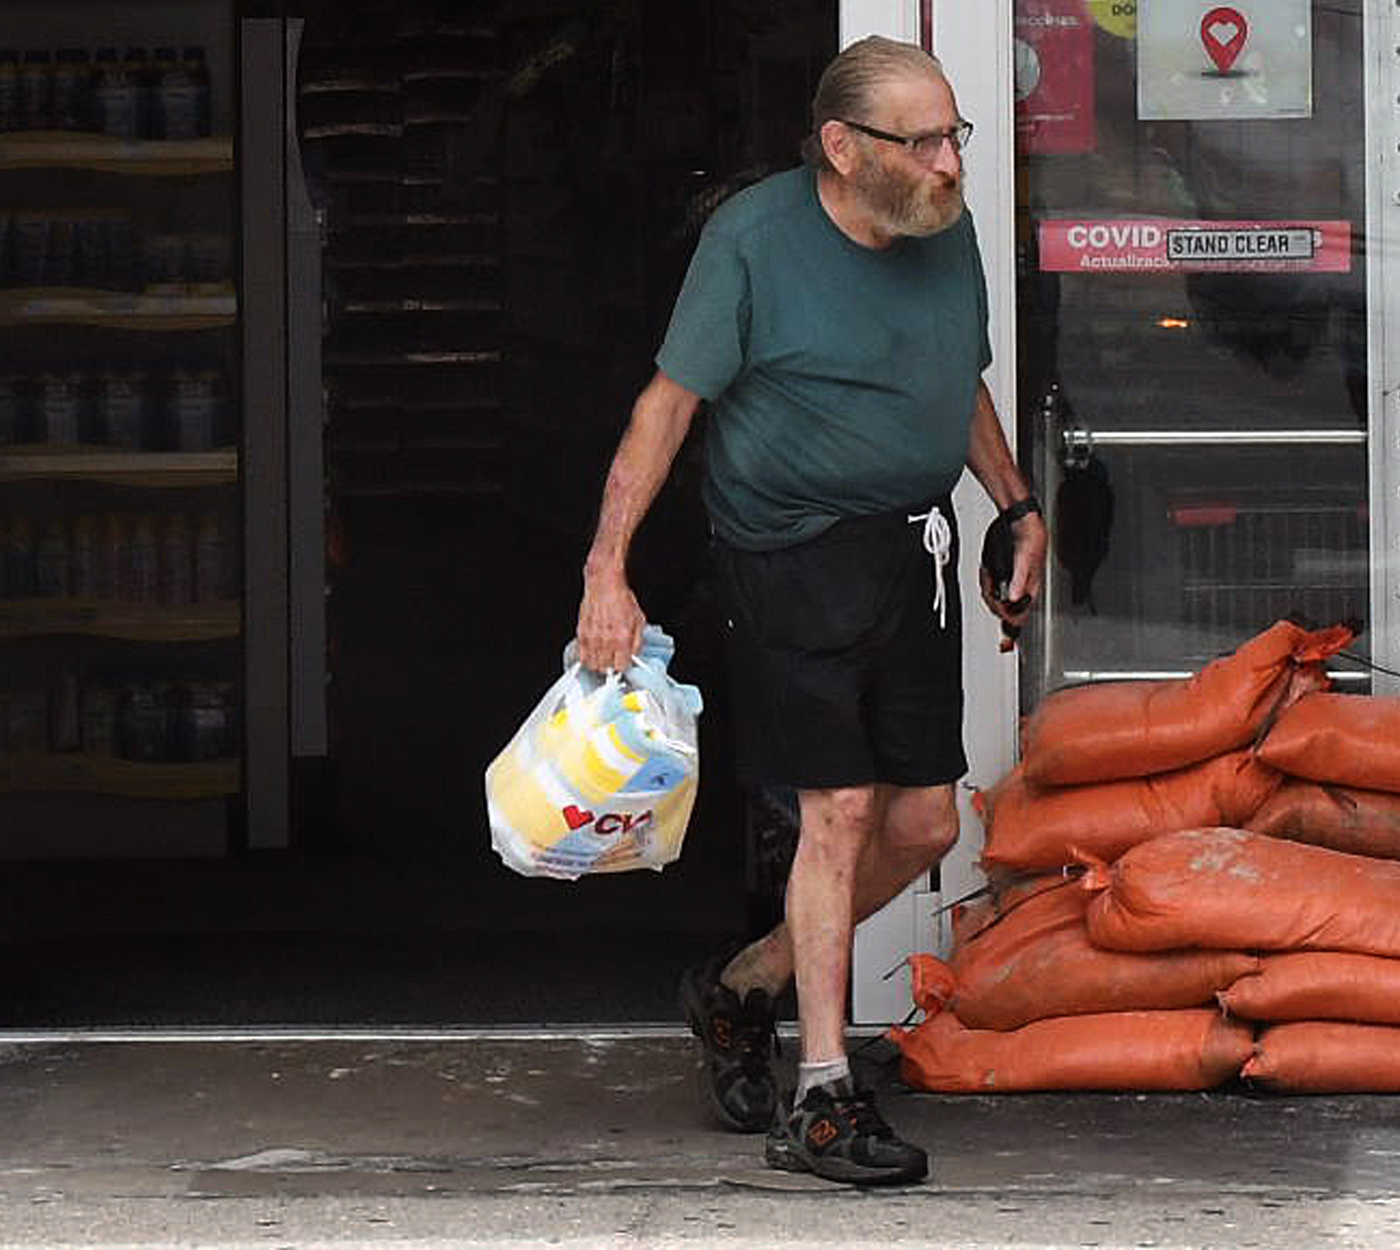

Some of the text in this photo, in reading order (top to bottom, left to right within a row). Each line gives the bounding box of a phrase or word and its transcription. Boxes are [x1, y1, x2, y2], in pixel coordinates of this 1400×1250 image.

[1172, 236, 1289, 254] STAND CLEAR
[594, 810, 653, 835] CV
